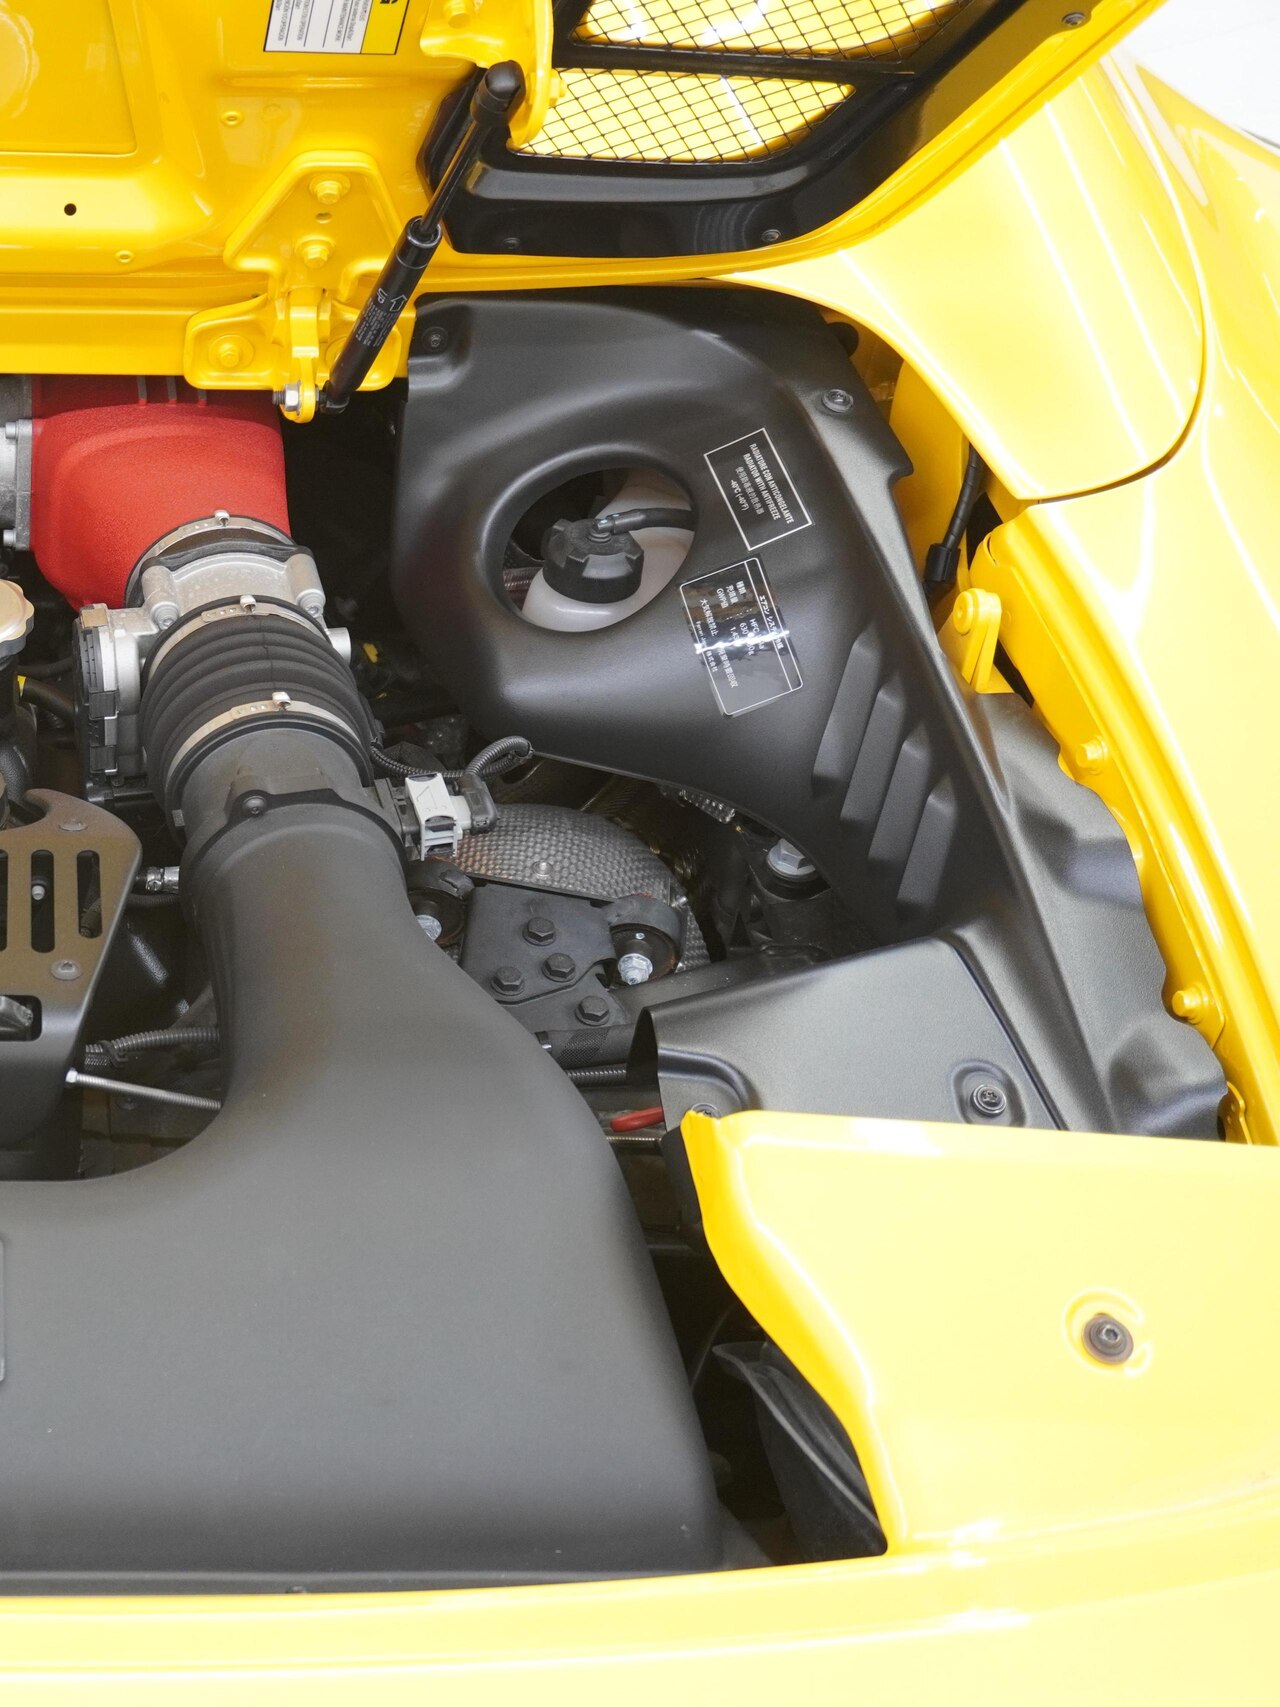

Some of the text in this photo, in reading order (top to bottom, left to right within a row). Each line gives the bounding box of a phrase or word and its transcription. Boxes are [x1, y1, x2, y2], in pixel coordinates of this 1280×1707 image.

[377, 287, 388, 304] UP
[743, 453, 780, 520] RADIATOR WITH ANTIFREEZE
[749, 443, 794, 524] RADIATORE CON ANTICONGELANTE
[736, 580, 747, 595] 種類
[759, 595, 770, 615] エアコン
